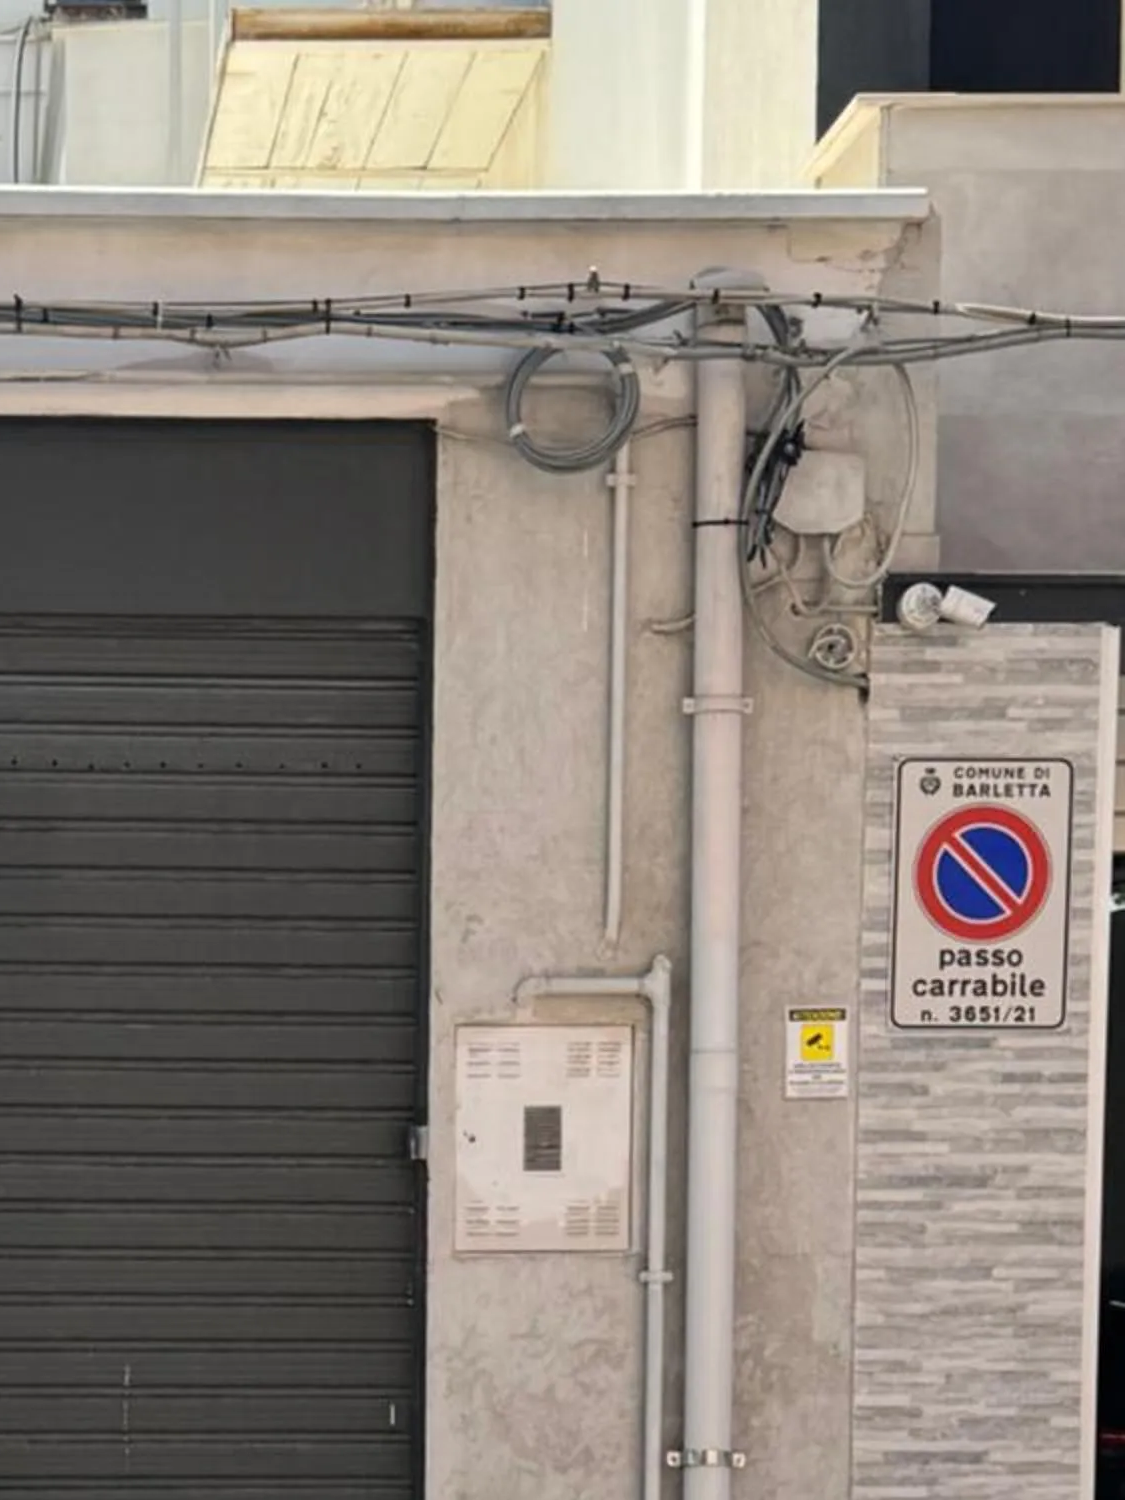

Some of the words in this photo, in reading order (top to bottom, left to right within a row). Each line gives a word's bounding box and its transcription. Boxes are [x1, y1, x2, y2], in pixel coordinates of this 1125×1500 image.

[953, 767, 1025, 780] COMUNE
[1033, 767, 1051, 780] DI
[952, 783, 1052, 798] BARLETTA
[939, 948, 1024, 971] passo
[912, 972, 1046, 998] carrabile
[920, 1008, 938, 1022] n.
[948, 1005, 1036, 1023] 3651/21
